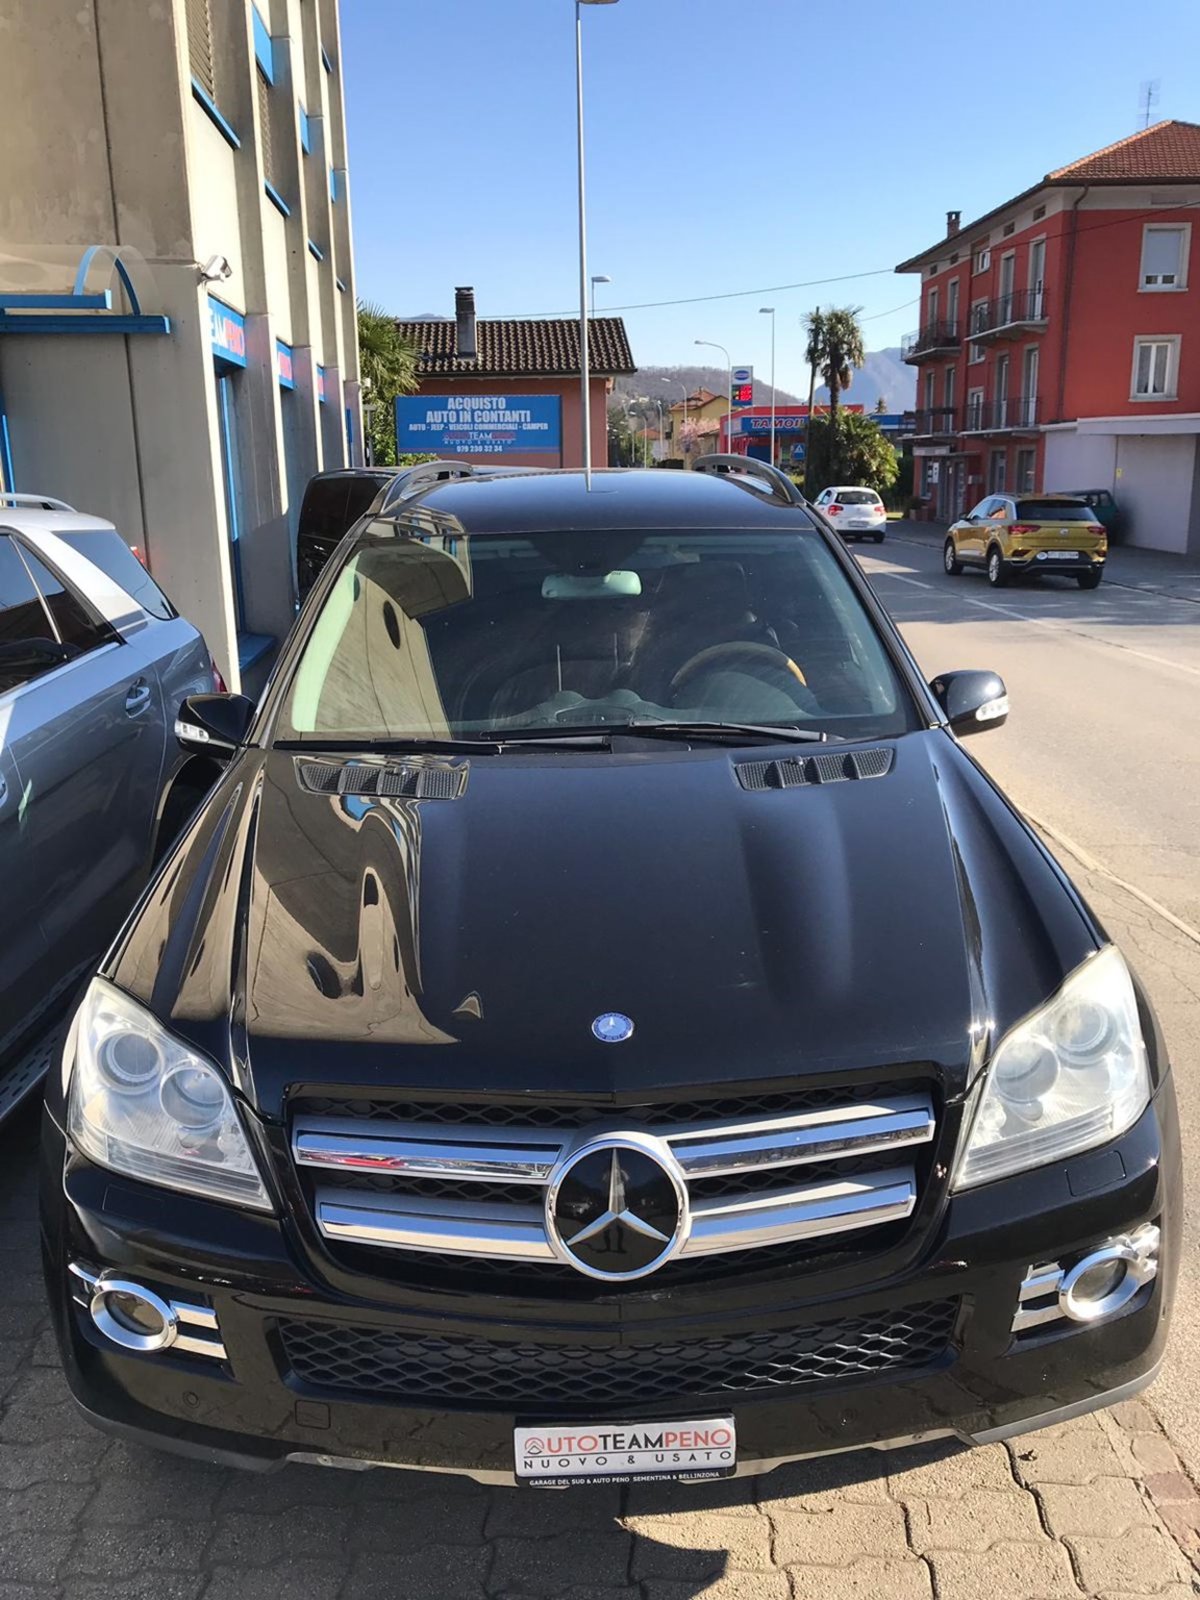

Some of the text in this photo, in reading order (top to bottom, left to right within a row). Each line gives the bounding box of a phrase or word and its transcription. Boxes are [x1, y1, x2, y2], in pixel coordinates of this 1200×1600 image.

[447, 397, 506, 410] ACQUISTO
[426, 410, 531, 423] AUTO IN CONTANTI
[474, 423, 518, 431] COMMERCIALI
[750, 418, 806, 429] TAMOIL
[524, 1451, 732, 1469] NUOVO & USATO
[632, 1474, 672, 1482] SEMENTINA
[678, 1471, 720, 1479] BELLINZONA
